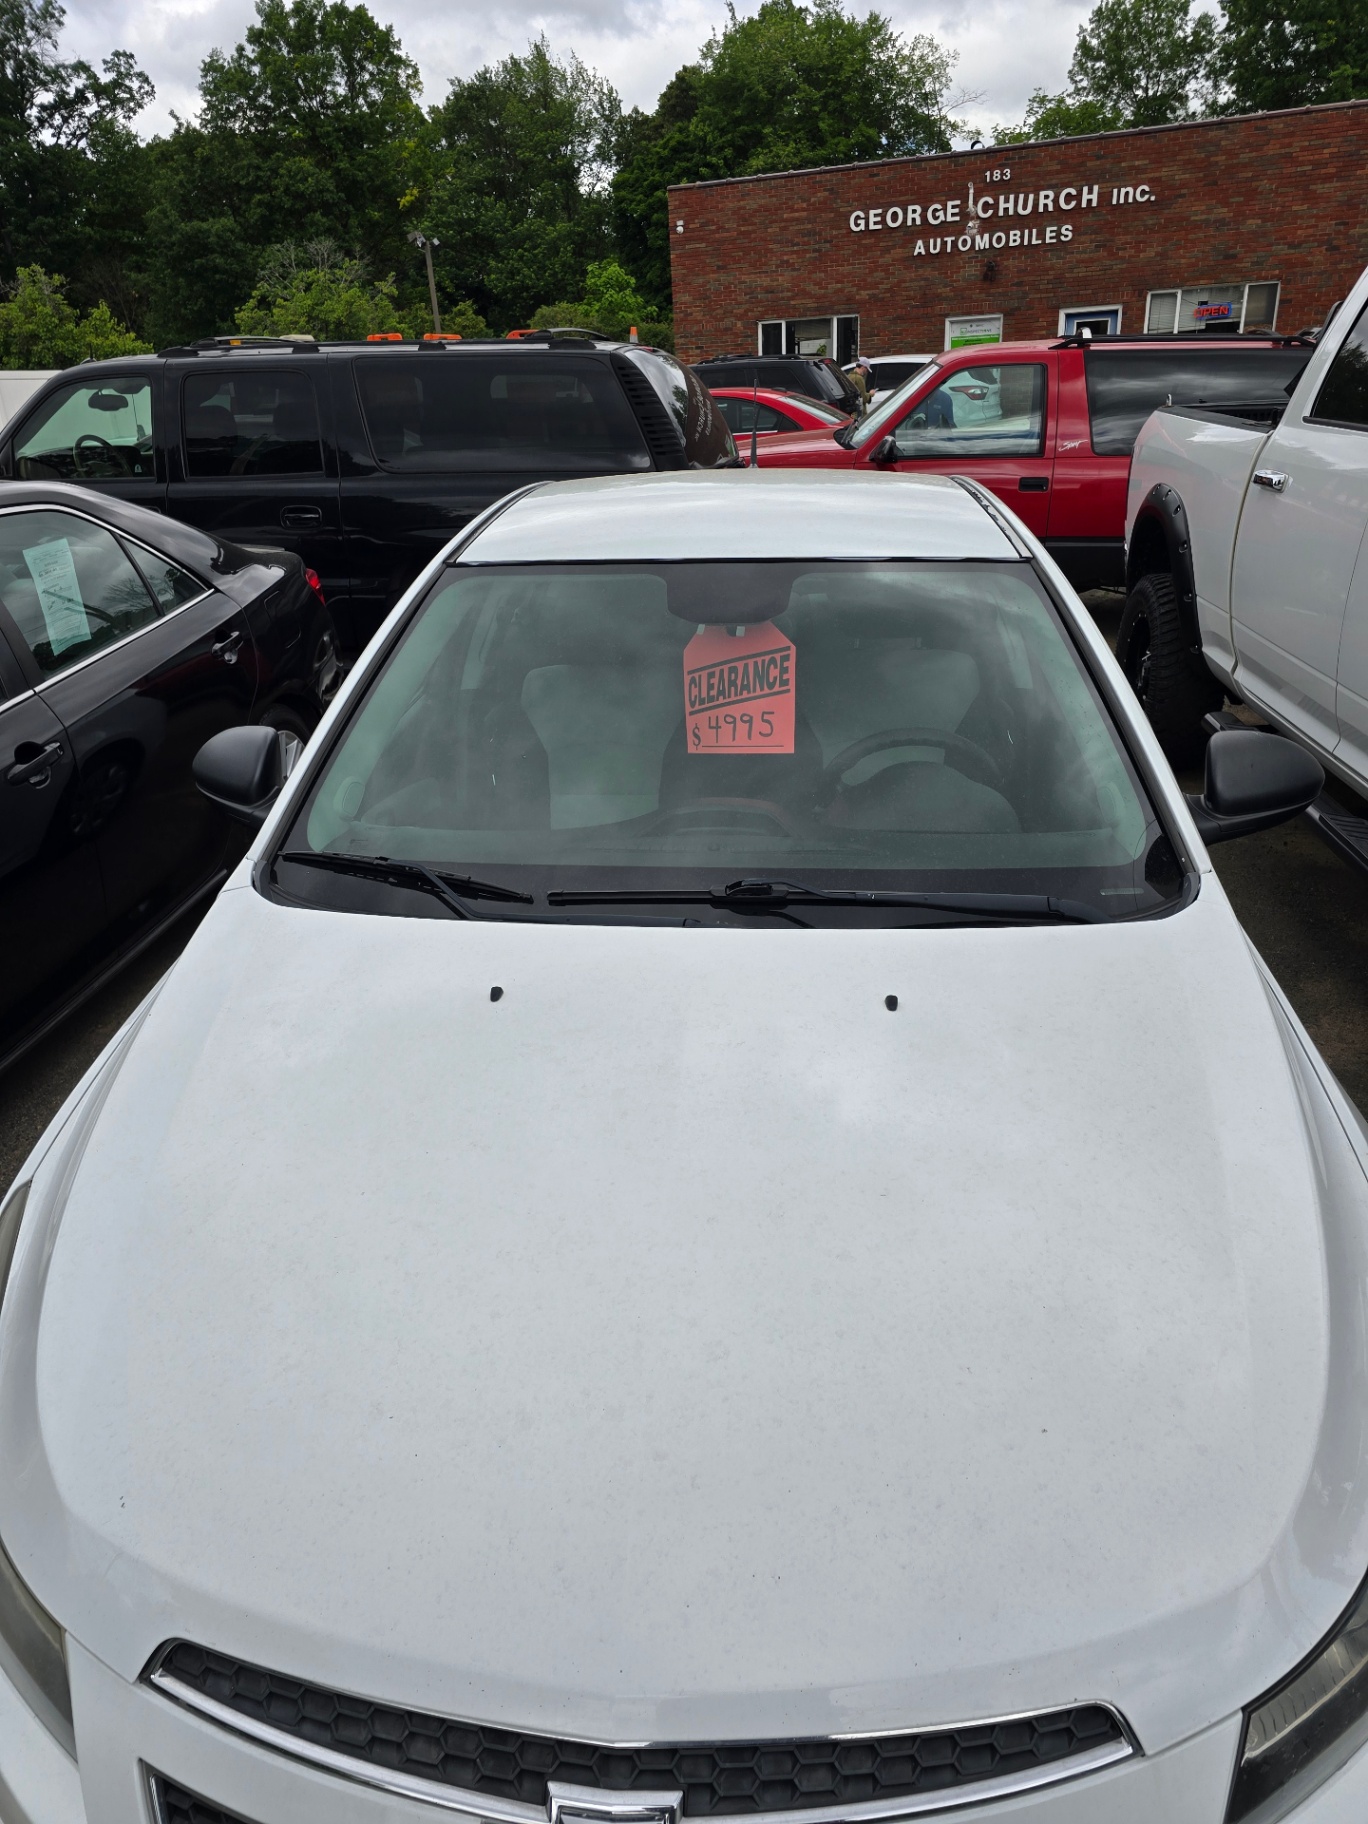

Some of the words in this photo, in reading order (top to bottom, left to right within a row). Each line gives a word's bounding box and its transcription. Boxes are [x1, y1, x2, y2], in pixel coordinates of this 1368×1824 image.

[985, 168, 1011, 183] 183
[849, 200, 961, 232] GEORGE
[976, 184, 1099, 219] CHURCH
[913, 224, 1074, 256] AUTOMOBILES
[1193, 305, 1229, 318] OPEN
[688, 653, 791, 709] CLEARANCE
